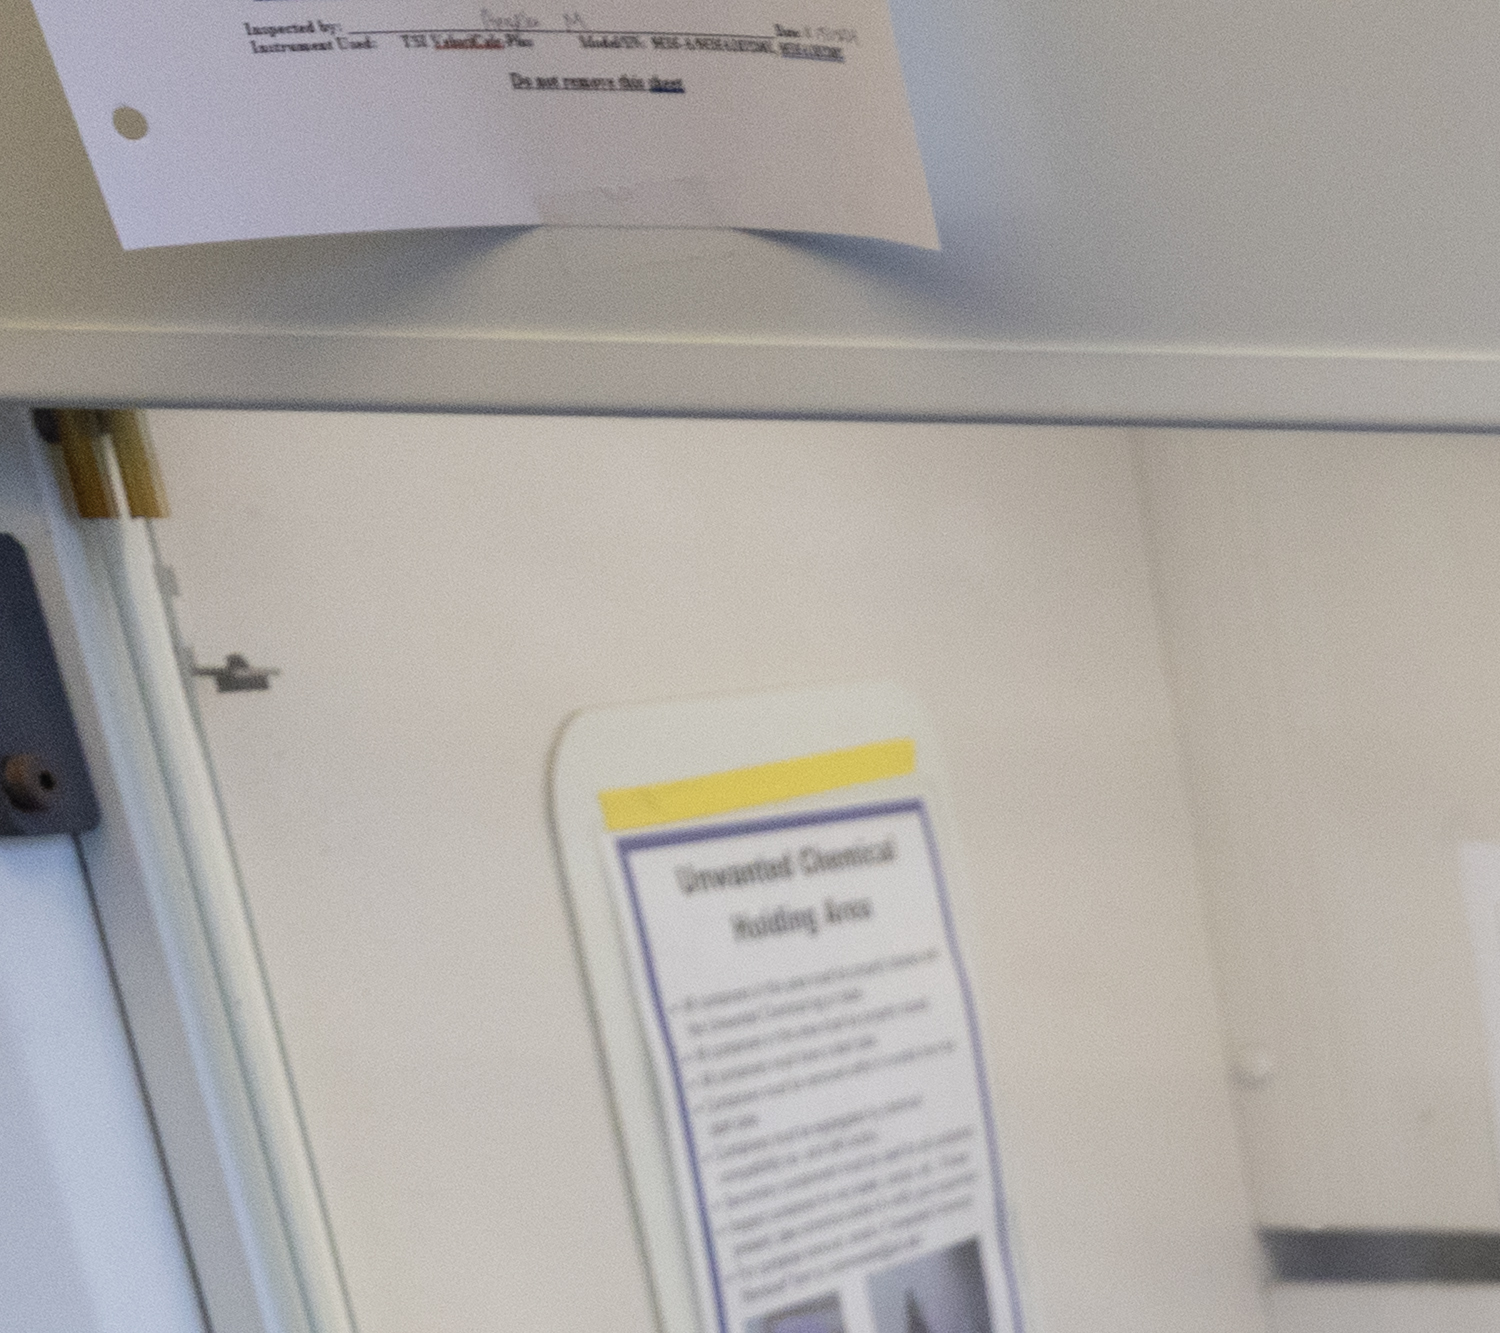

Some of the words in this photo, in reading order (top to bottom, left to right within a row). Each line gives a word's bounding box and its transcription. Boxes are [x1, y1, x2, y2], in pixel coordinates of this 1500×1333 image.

[243, 21, 315, 37] Inspected
[250, 39, 333, 54] Instrument
[509, 72, 533, 90] Do
[535, 75, 559, 90] not
[562, 76, 615, 91] remove
[618, 75, 645, 91] this
[675, 850, 795, 896] Unwanted
[799, 834, 897, 876] Chemical
[730, 902, 819, 943] Holding
[822, 897, 874, 927] Area
